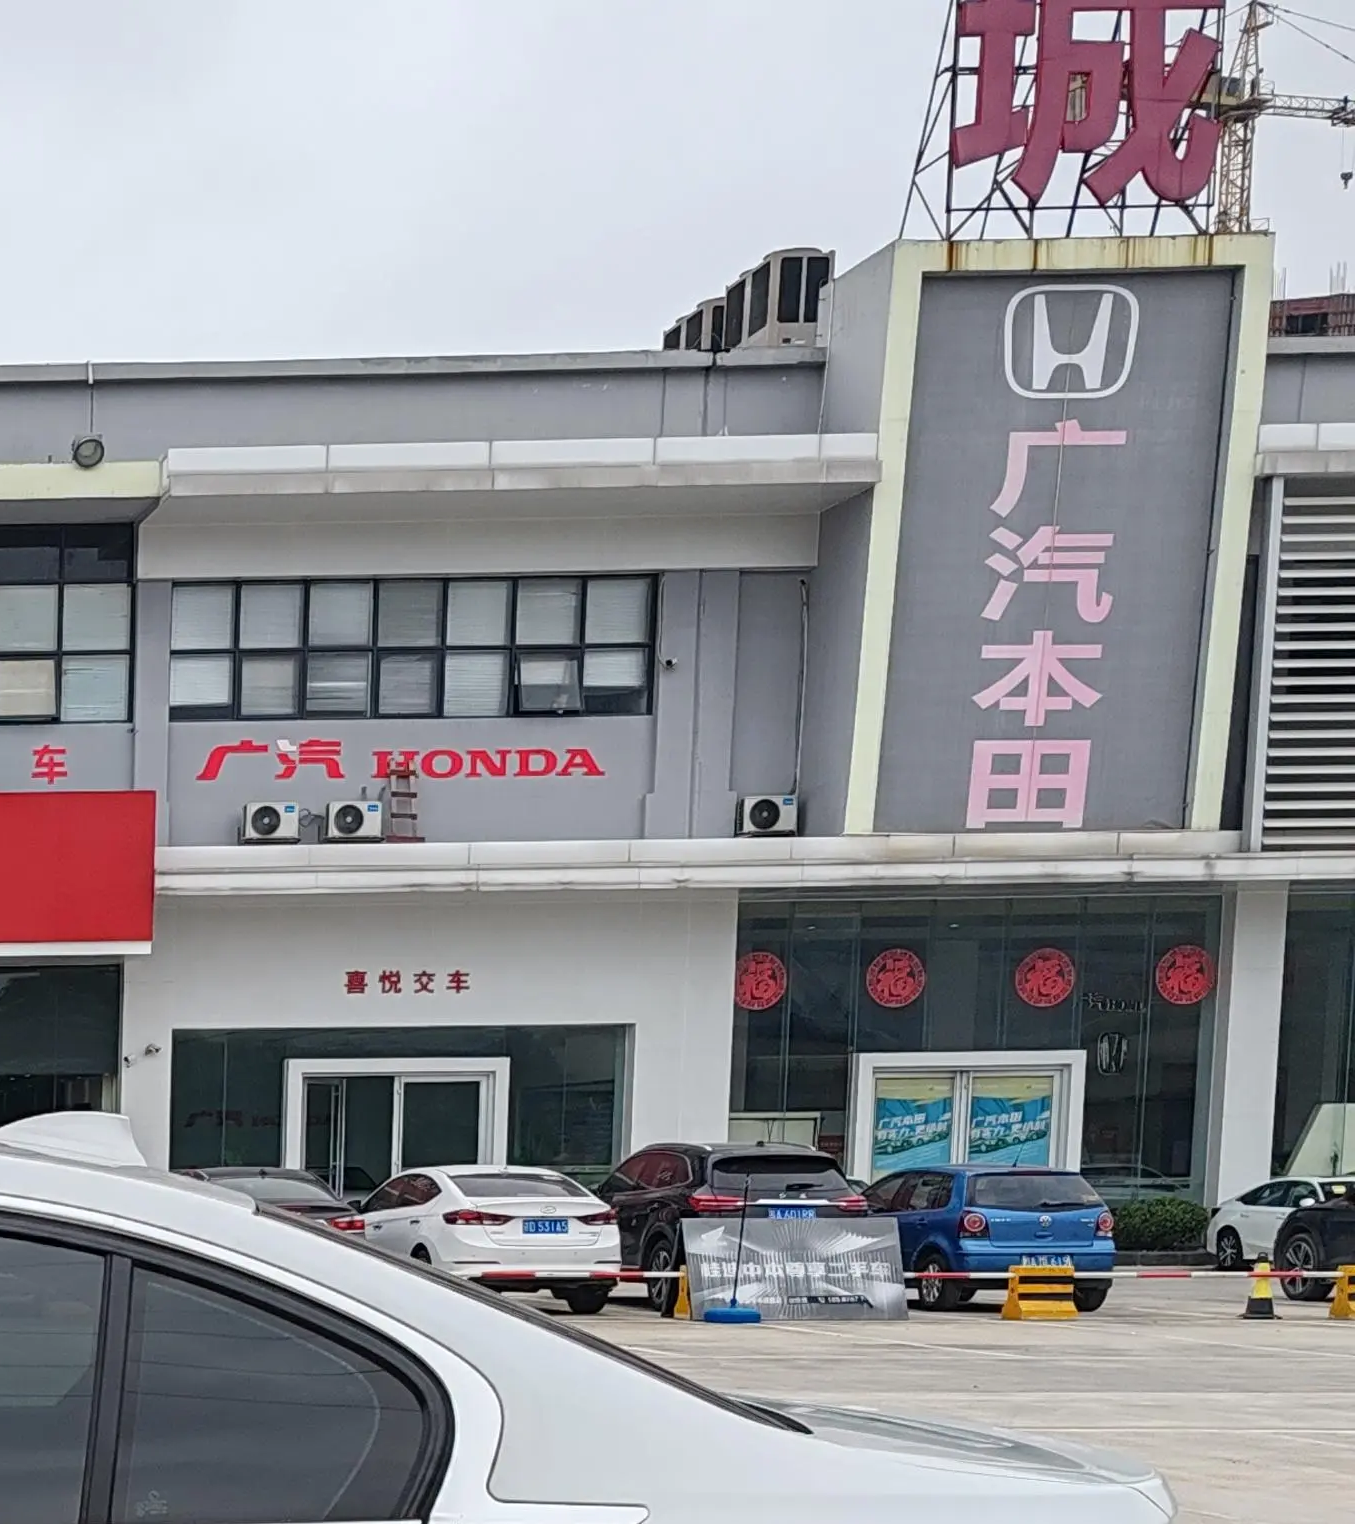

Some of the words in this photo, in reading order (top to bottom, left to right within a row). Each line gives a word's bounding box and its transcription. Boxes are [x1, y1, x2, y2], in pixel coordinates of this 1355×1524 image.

[952, 0, 1225, 206] 城
[965, 420, 1127, 830] 广汽本田
[196, 739, 346, 780] 广汽
[370, 748, 606, 779] HONDA
[344, 970, 472, 995] 喜悦交车
